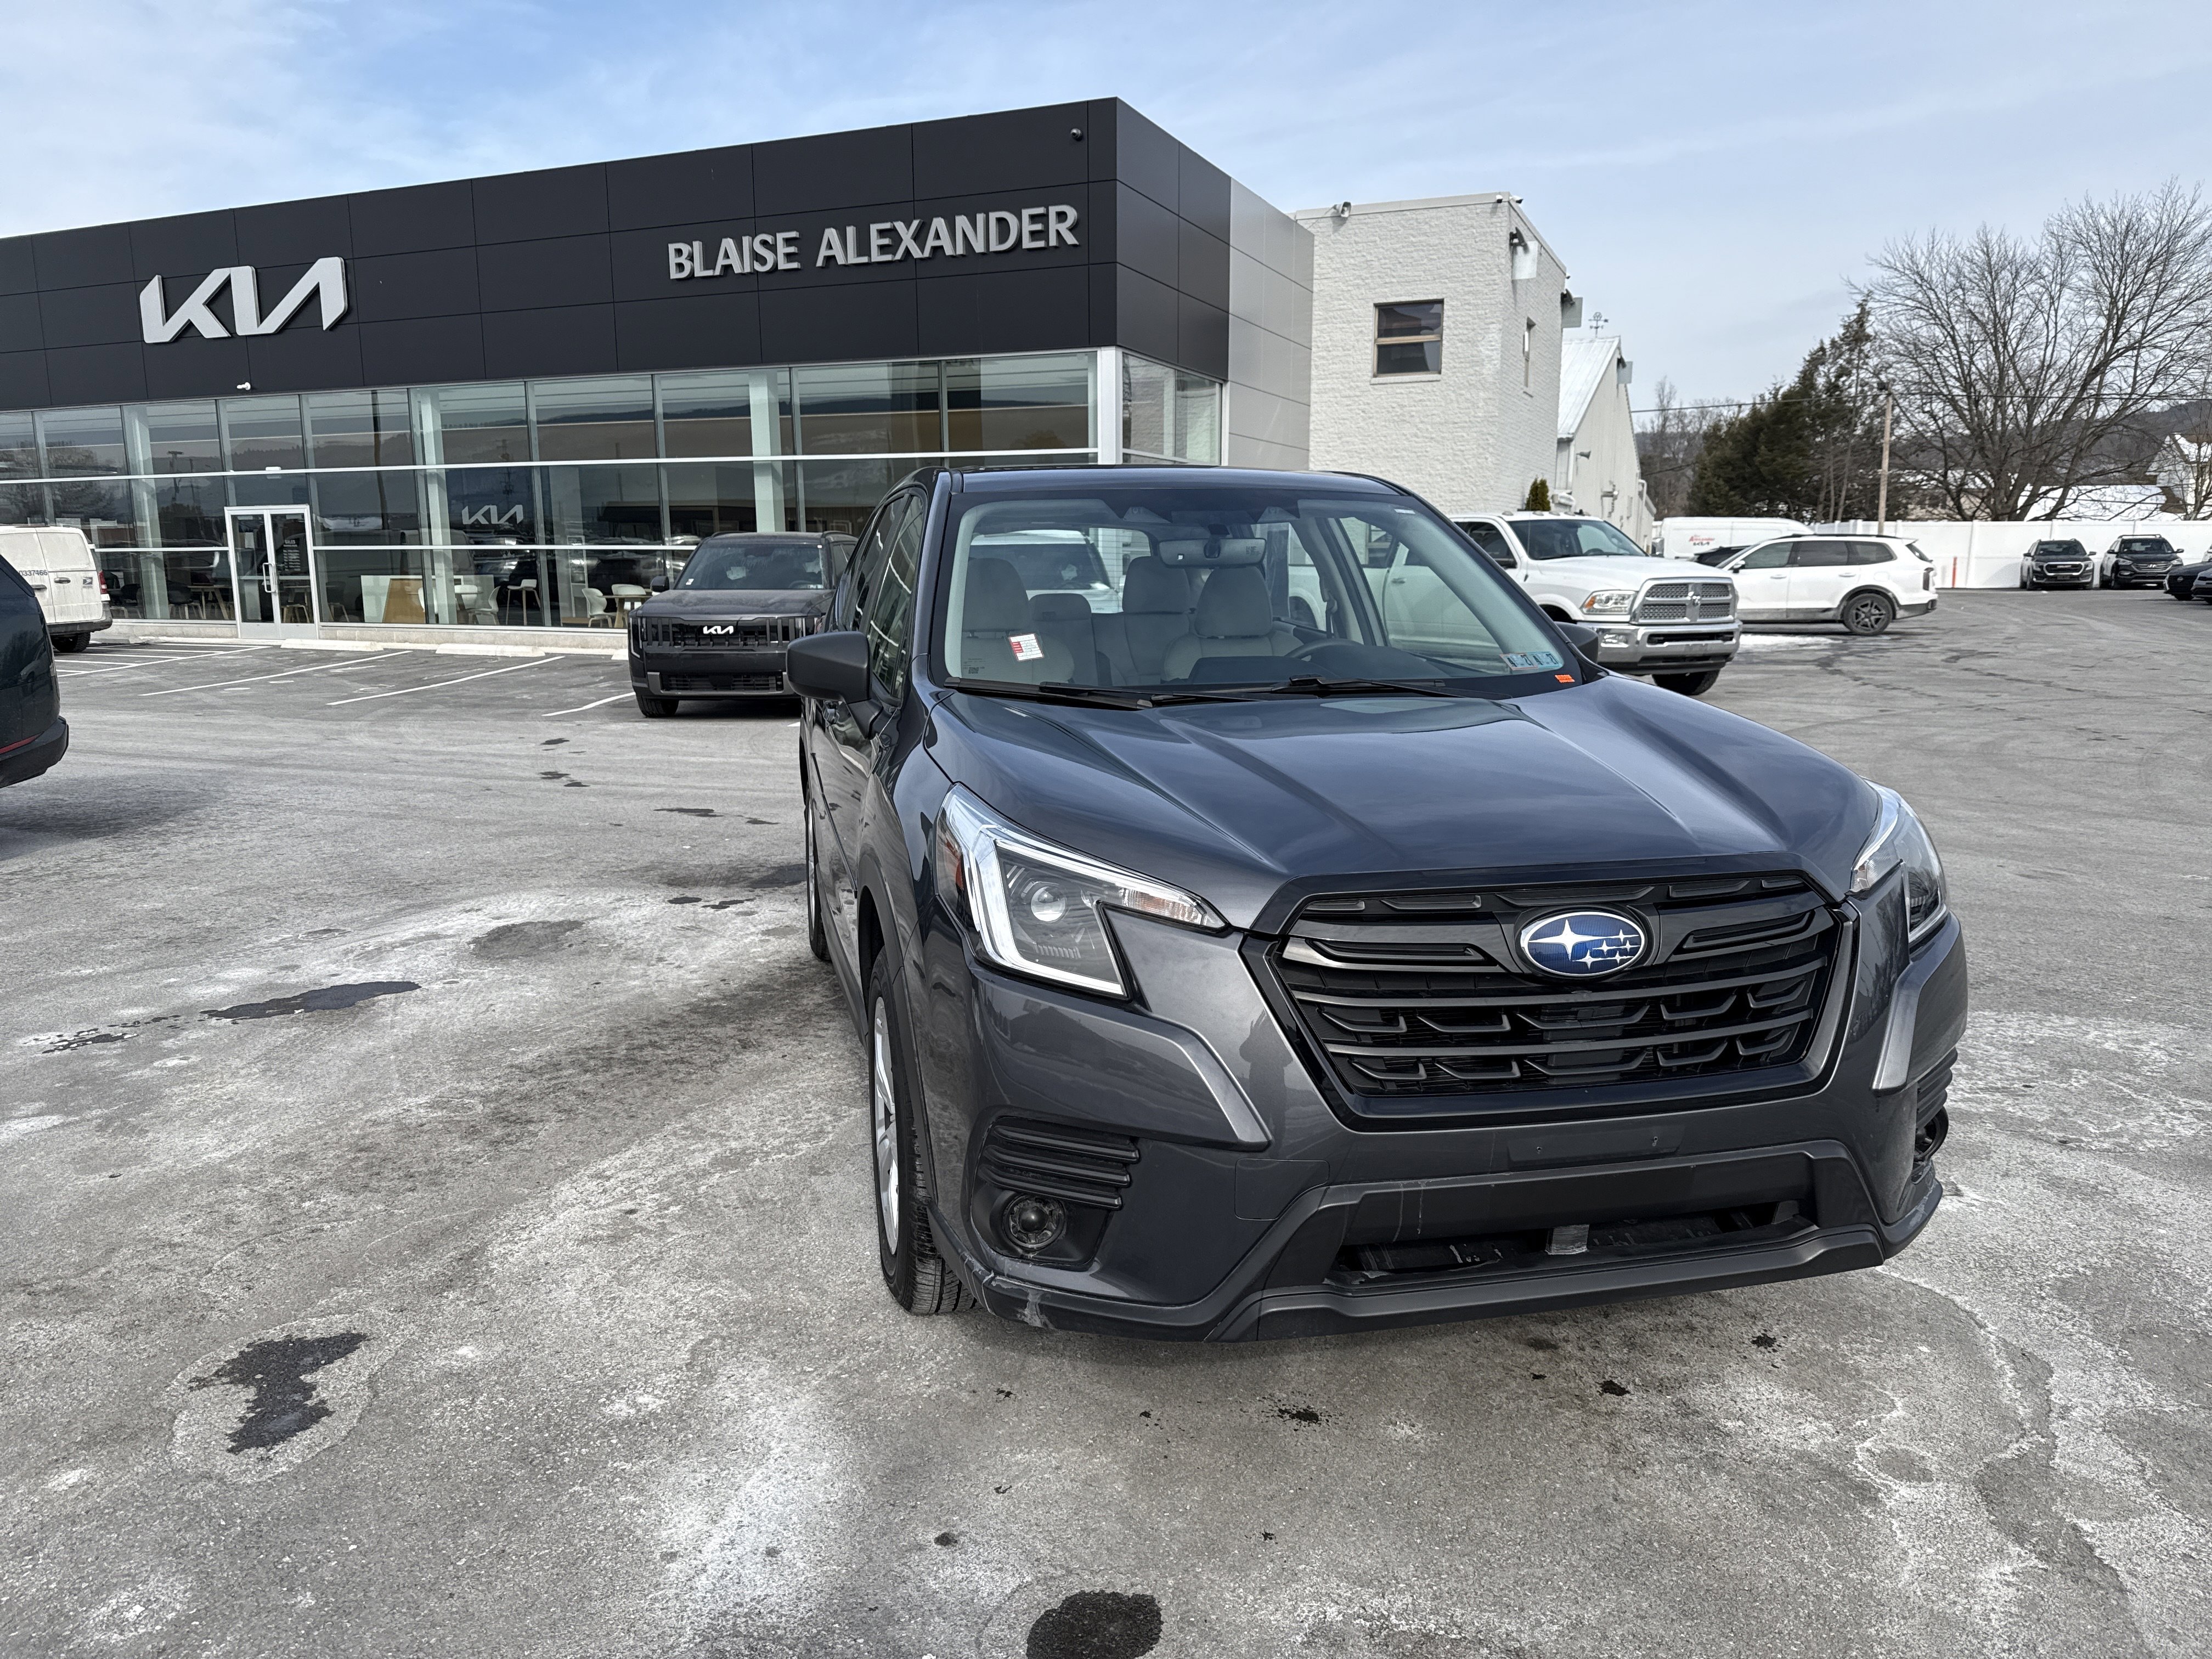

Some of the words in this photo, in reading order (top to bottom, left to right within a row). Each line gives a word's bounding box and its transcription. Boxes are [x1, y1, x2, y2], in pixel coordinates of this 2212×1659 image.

[668, 230, 801, 280] BLAISE
[816, 204, 1080, 268] ALEXANDER
[139, 256, 348, 343] KIA
[461, 504, 524, 524] KIA
[703, 625, 734, 635] KIA
